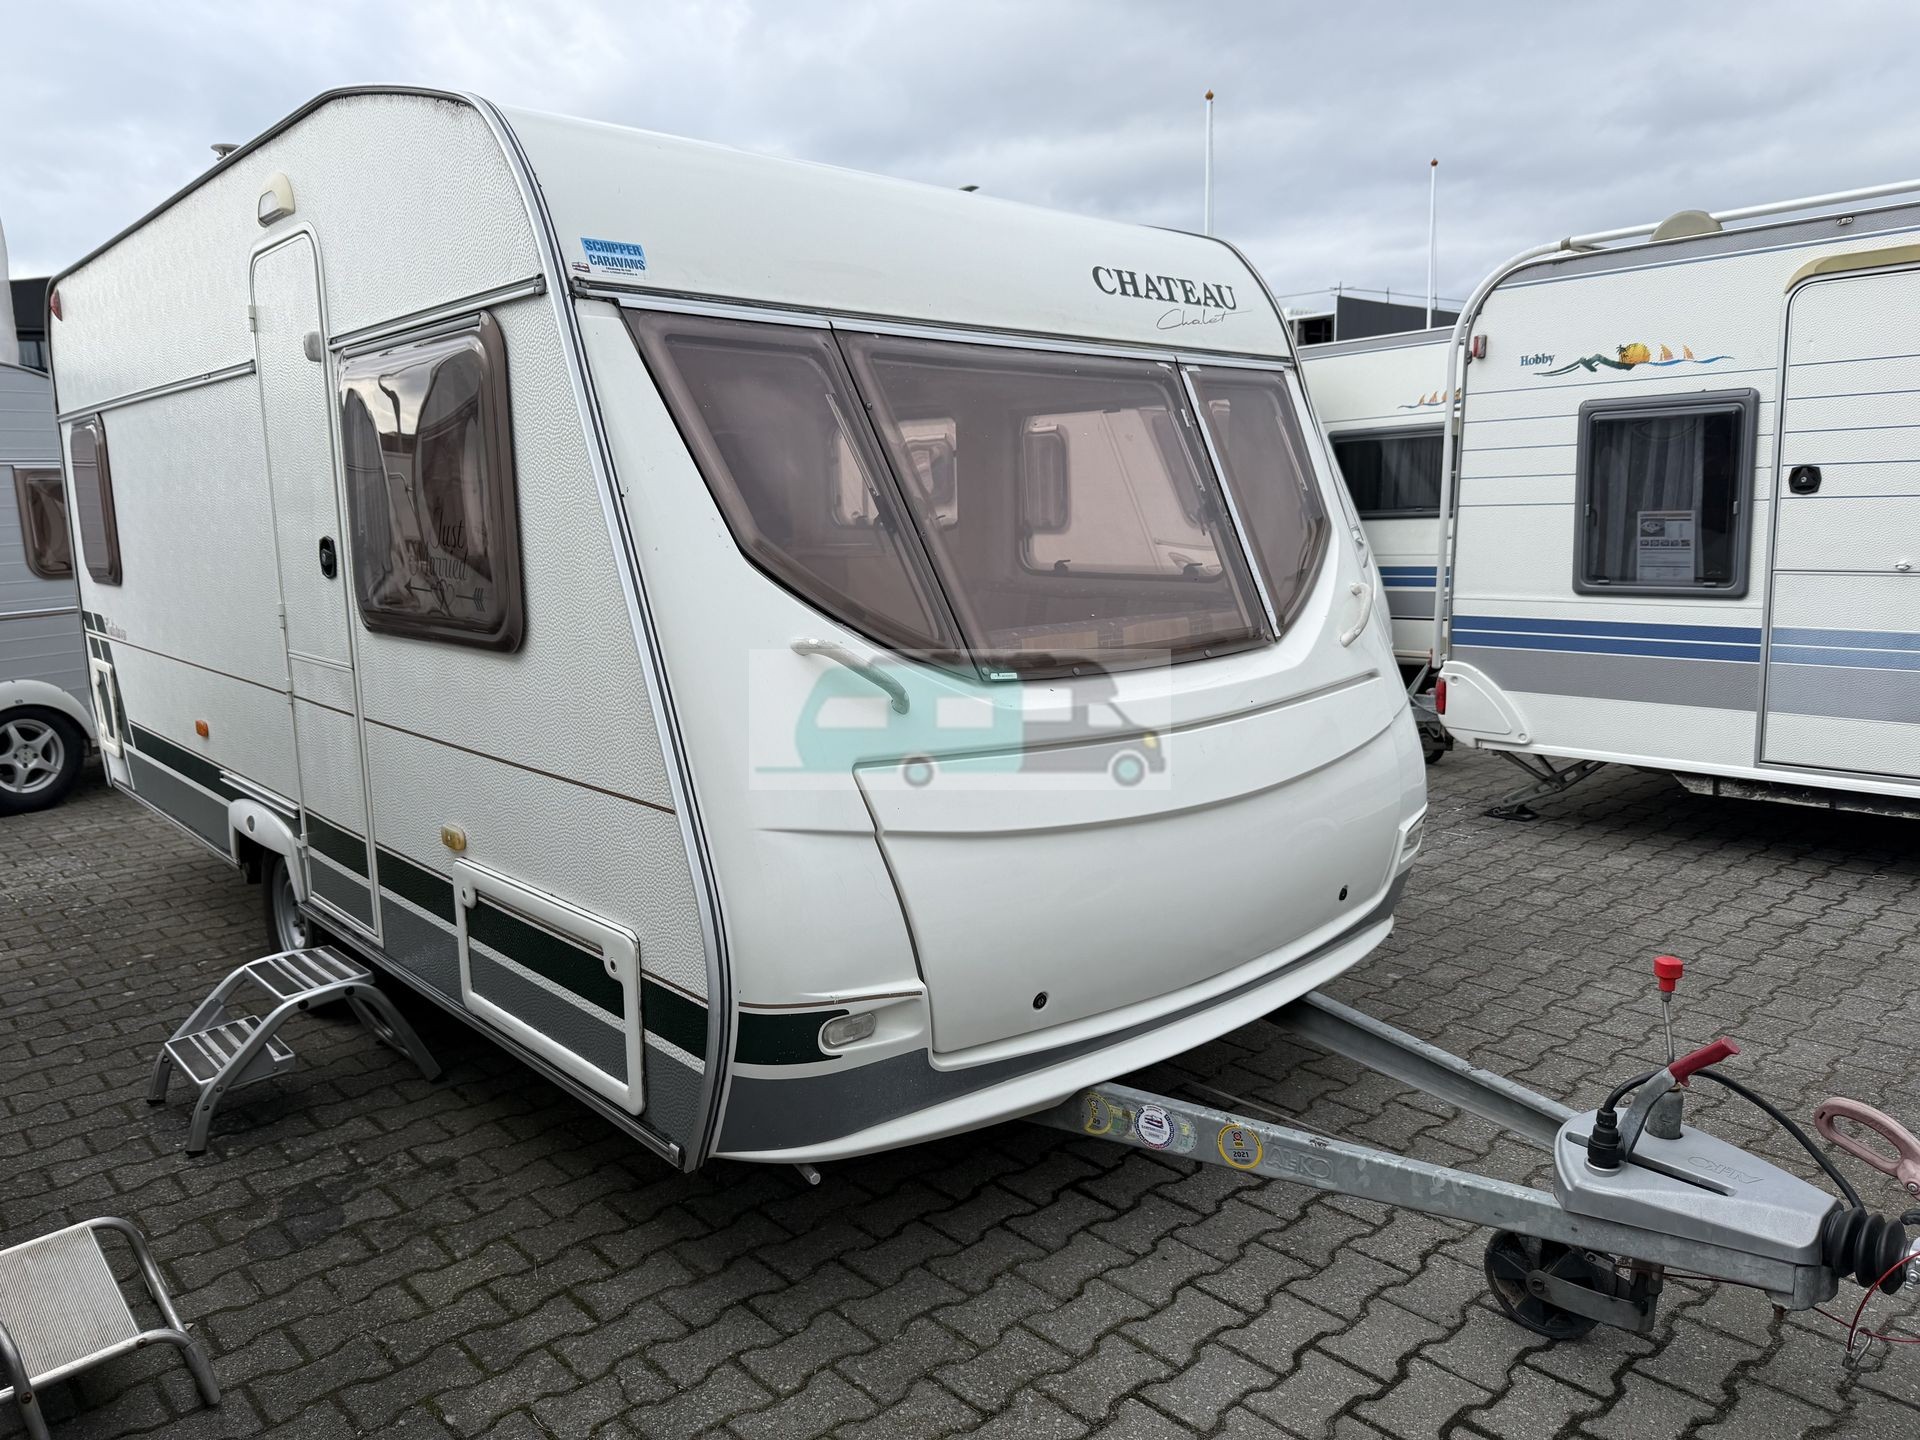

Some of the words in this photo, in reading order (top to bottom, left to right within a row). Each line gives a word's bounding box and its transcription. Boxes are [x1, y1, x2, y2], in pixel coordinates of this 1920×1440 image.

[584, 239, 642, 257] SCHIPPER
[588, 254, 646, 271] CARAVANS
[1092, 265, 1237, 310] CHATEAU
[1156, 308, 1253, 330] Chalet
[1520, 353, 1555, 367] Hobby
[430, 507, 465, 549] Just
[1233, 1150, 1249, 1158] 2021
